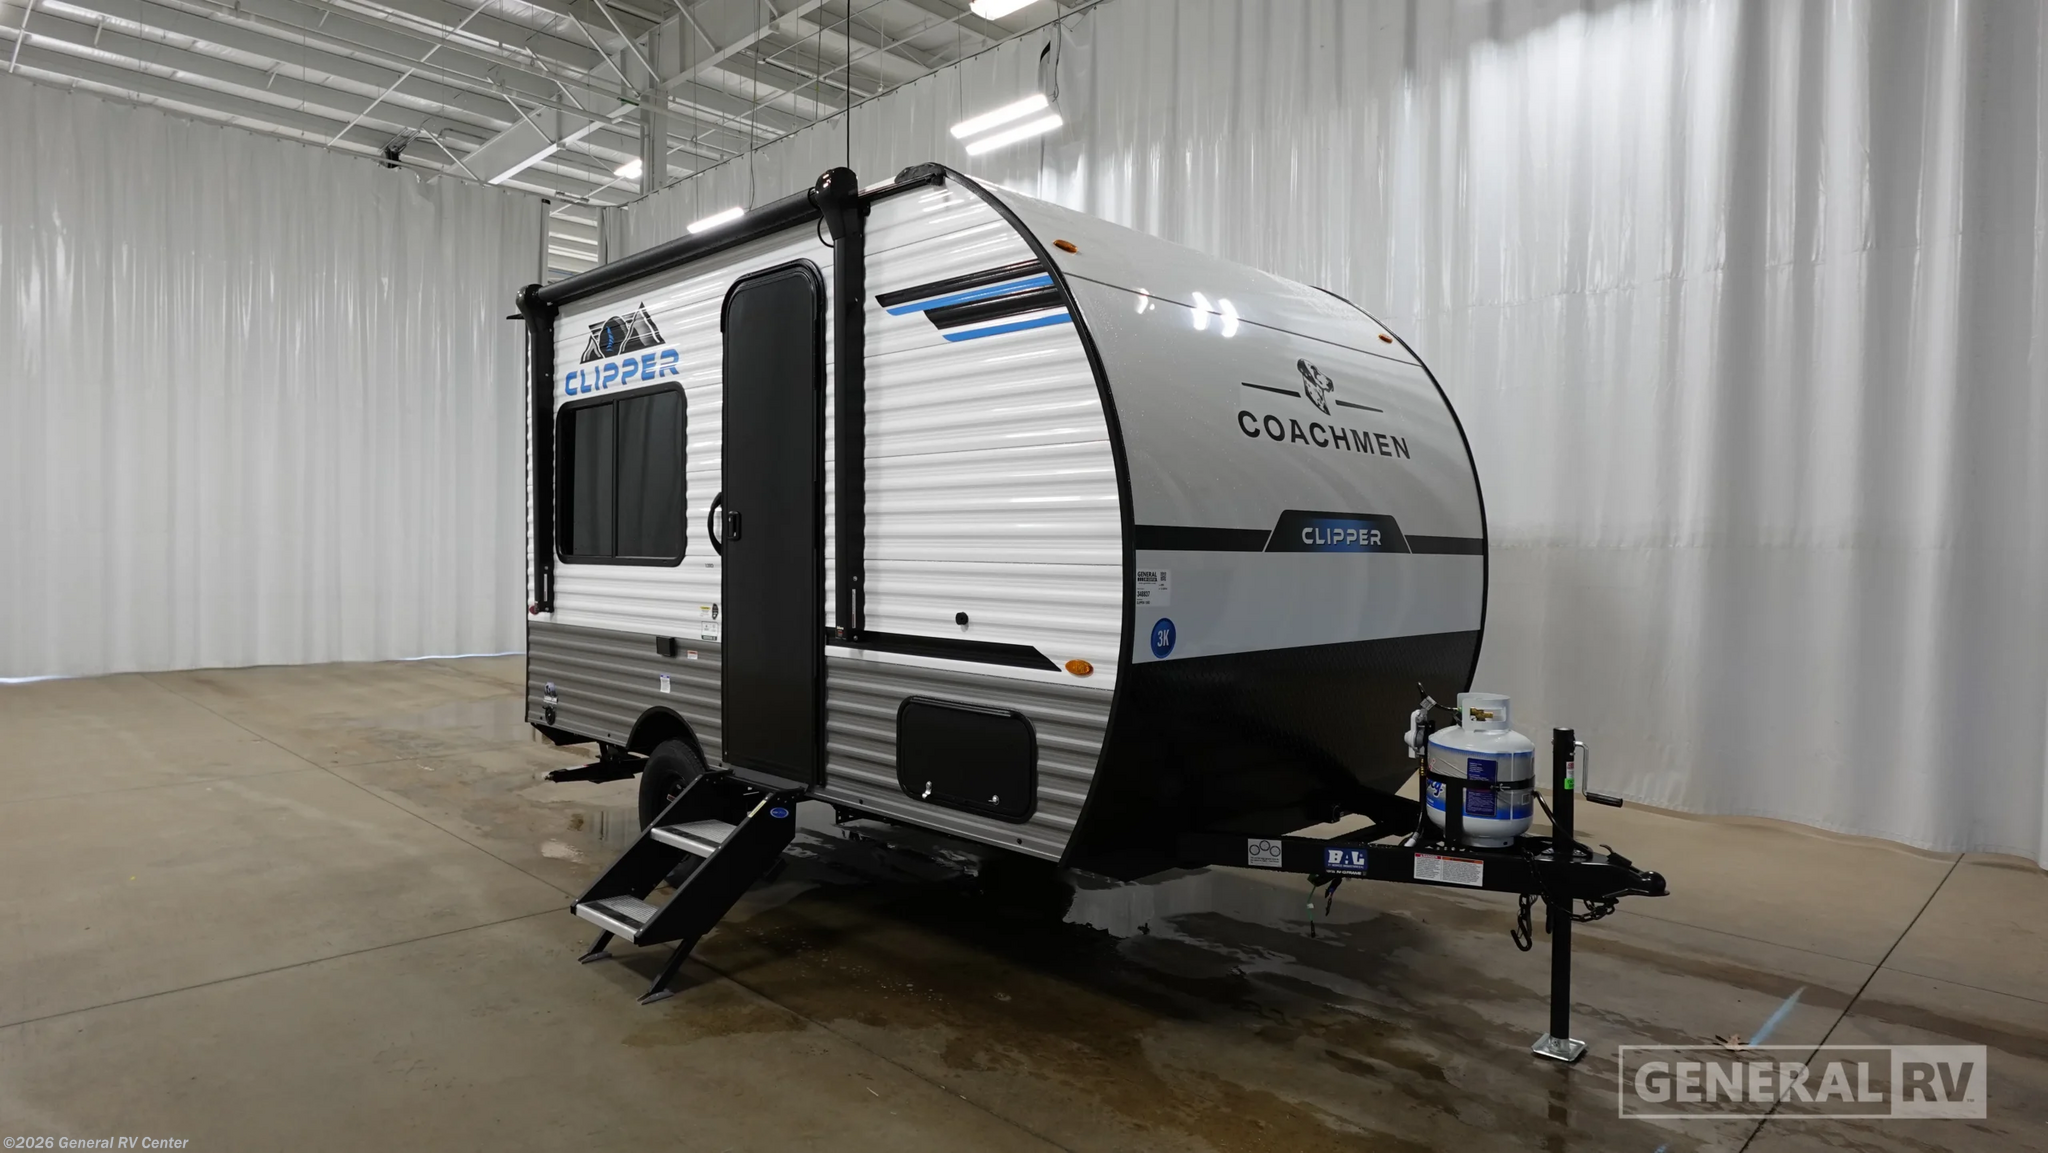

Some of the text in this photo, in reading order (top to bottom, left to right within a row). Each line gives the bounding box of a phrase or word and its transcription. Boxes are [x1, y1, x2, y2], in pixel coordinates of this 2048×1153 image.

[565, 349, 679, 395] CLIPPER
[1237, 410, 1411, 459] COACHMEN
[1301, 527, 1382, 546] CLIPPER
[1157, 629, 1170, 647] 3K
